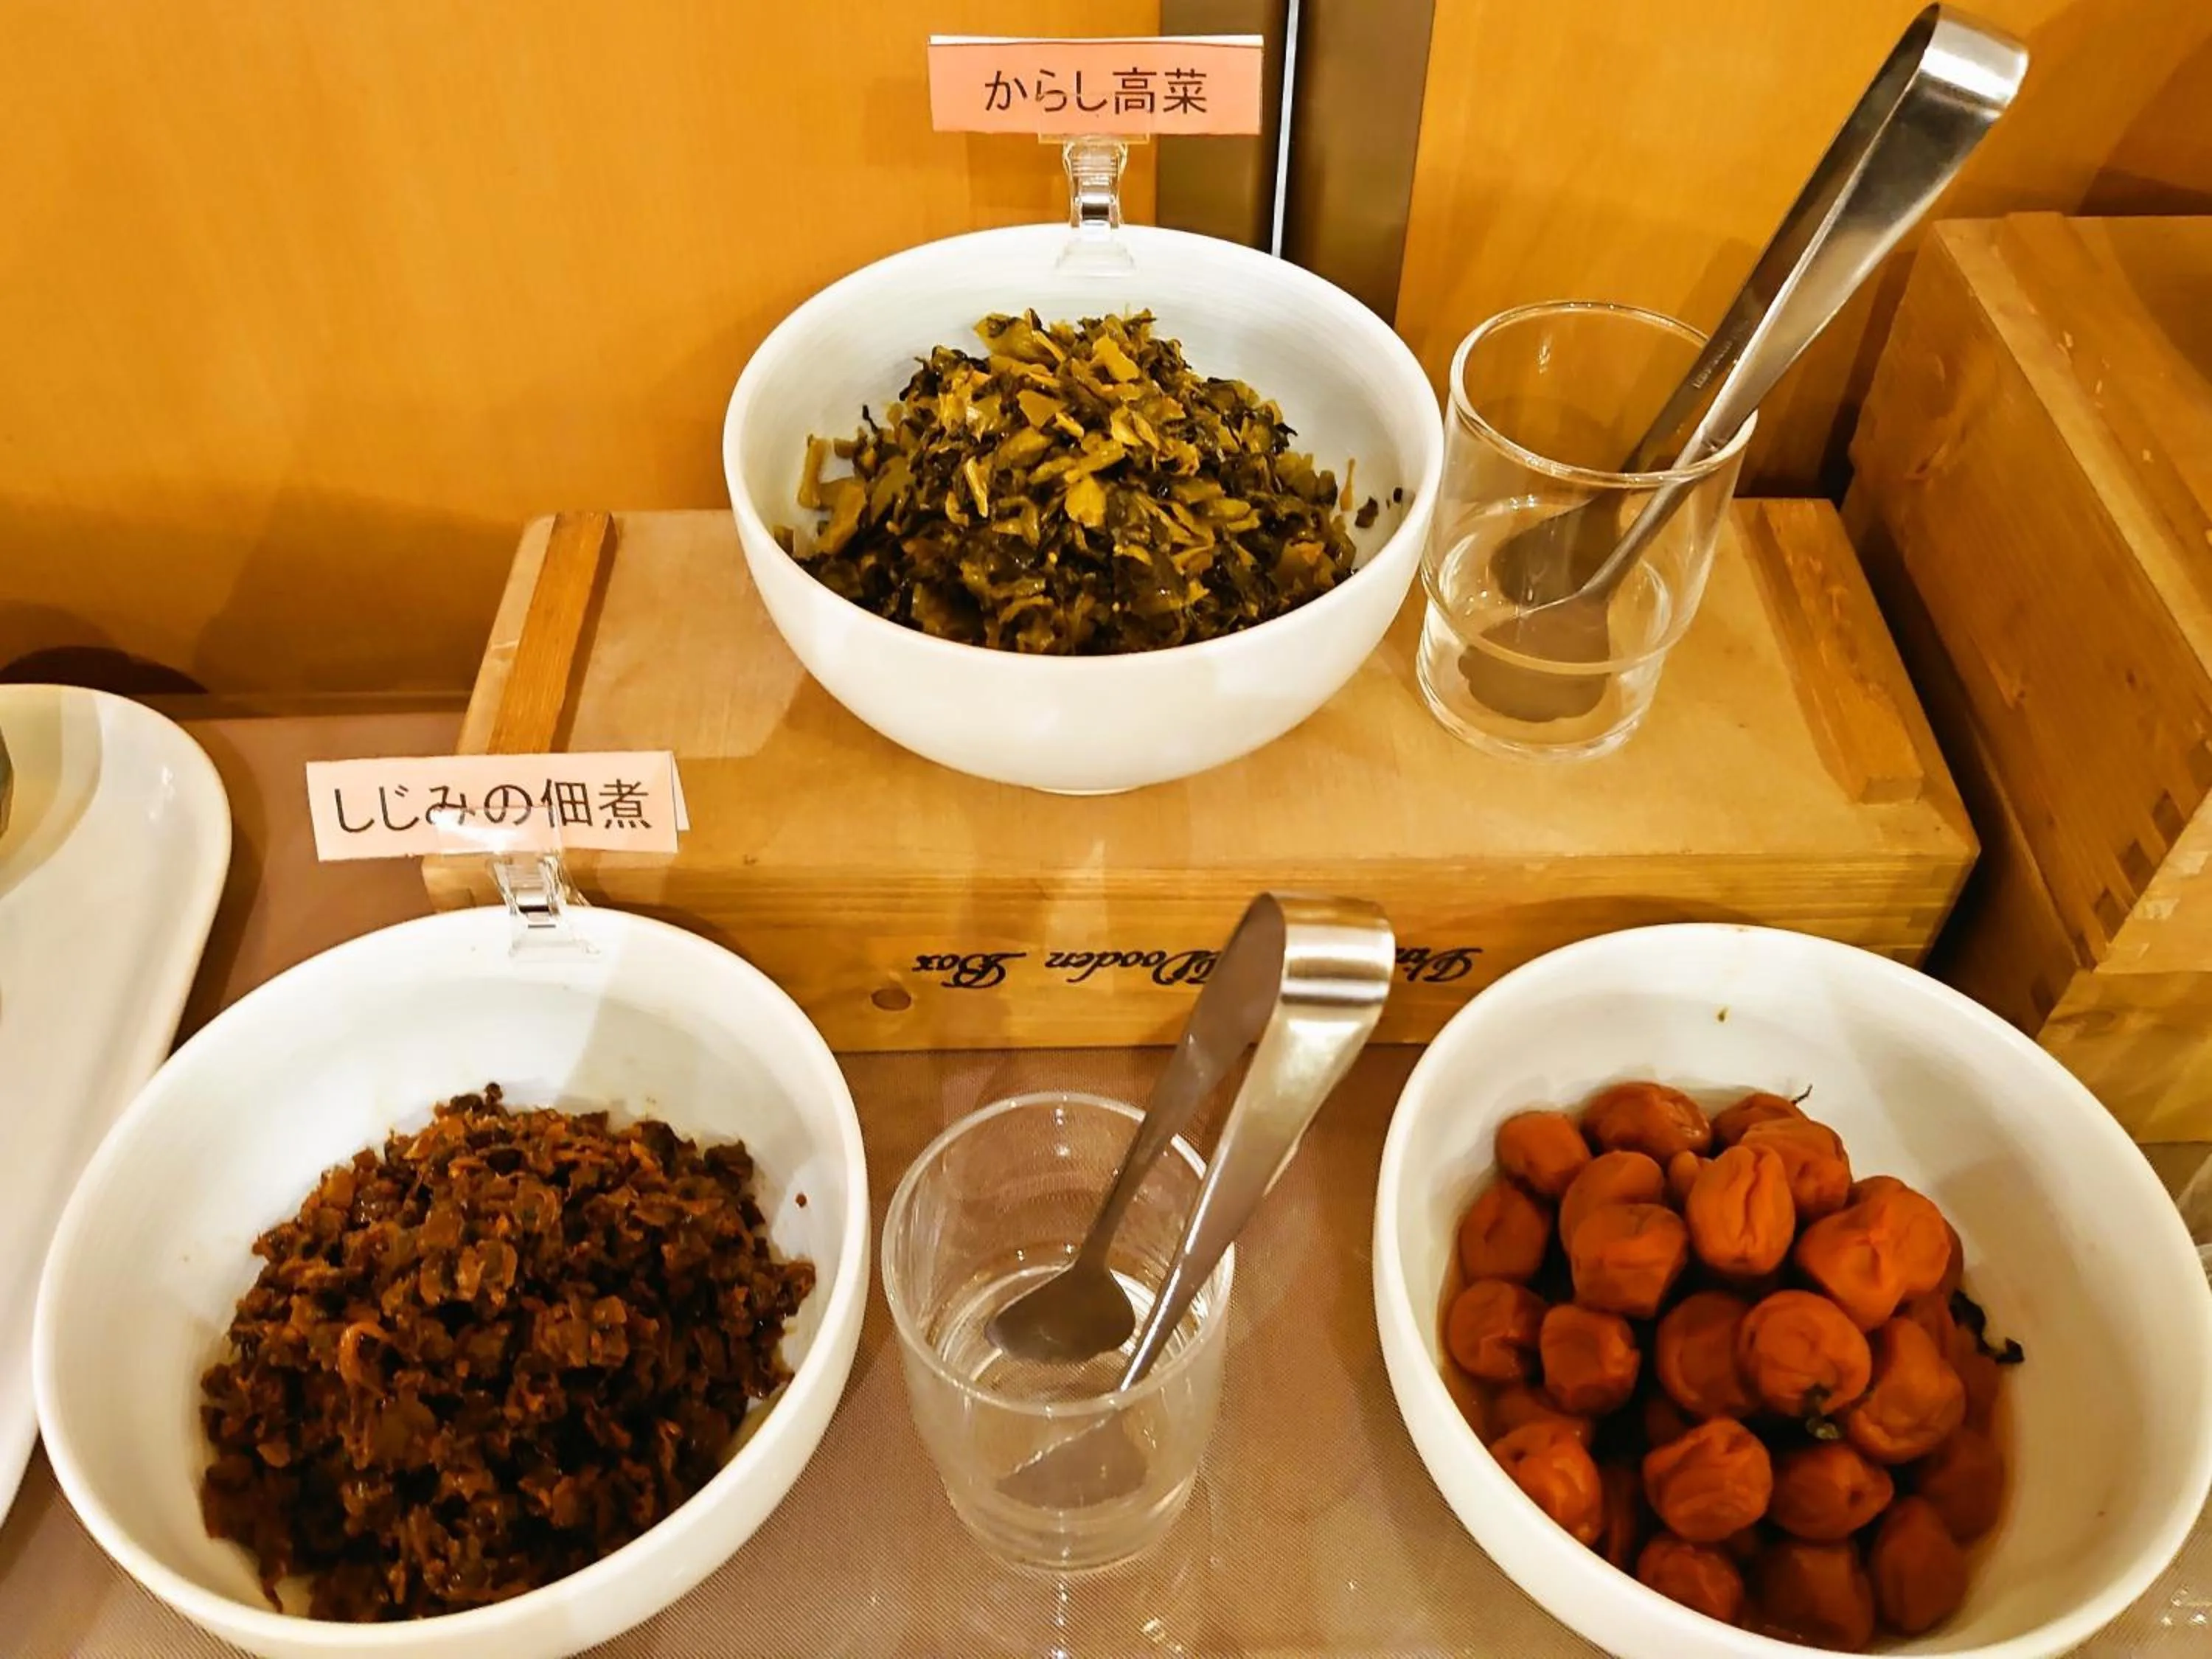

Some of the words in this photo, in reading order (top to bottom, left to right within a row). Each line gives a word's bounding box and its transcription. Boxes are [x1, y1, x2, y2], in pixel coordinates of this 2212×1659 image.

[984, 67, 1208, 115] からし高菜
[333, 778, 653, 833] しじみの佃煮
[911, 952, 1027, 989] Box
[1044, 950, 1224, 986] Wooden
